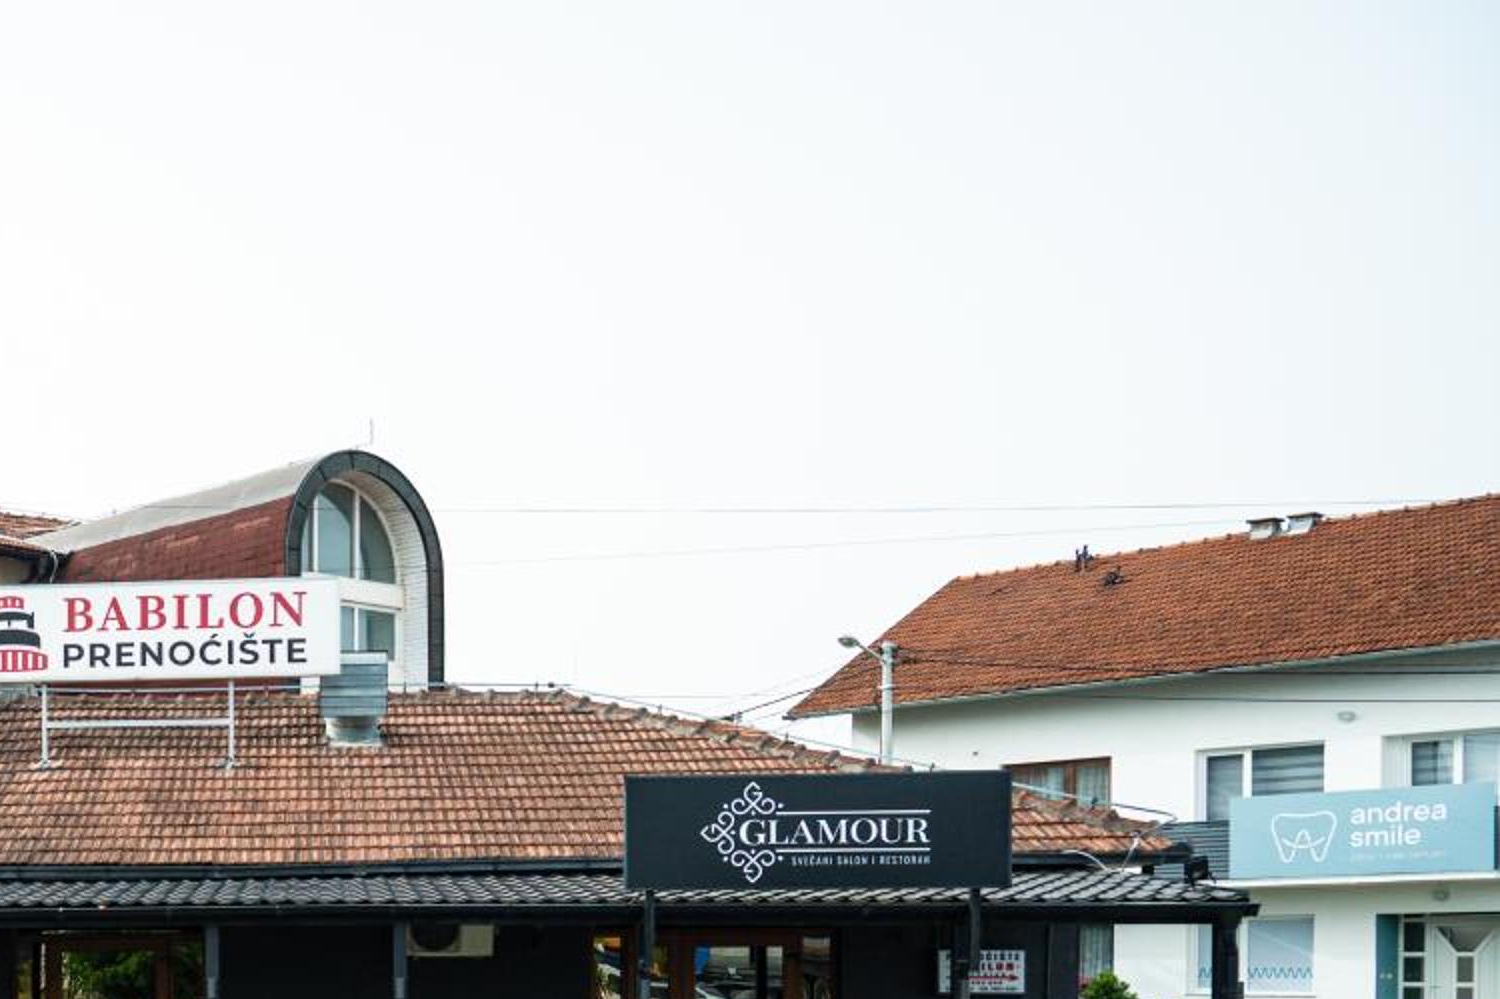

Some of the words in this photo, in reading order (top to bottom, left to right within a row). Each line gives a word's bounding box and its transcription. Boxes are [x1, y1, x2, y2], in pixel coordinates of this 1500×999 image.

[63, 591, 308, 633] BABILON
[63, 632, 308, 668] PRENOĆIŠTE
[1350, 800, 1447, 825] andrea
[739, 817, 931, 847] GLAMOUR
[1349, 825, 1421, 848] smile
